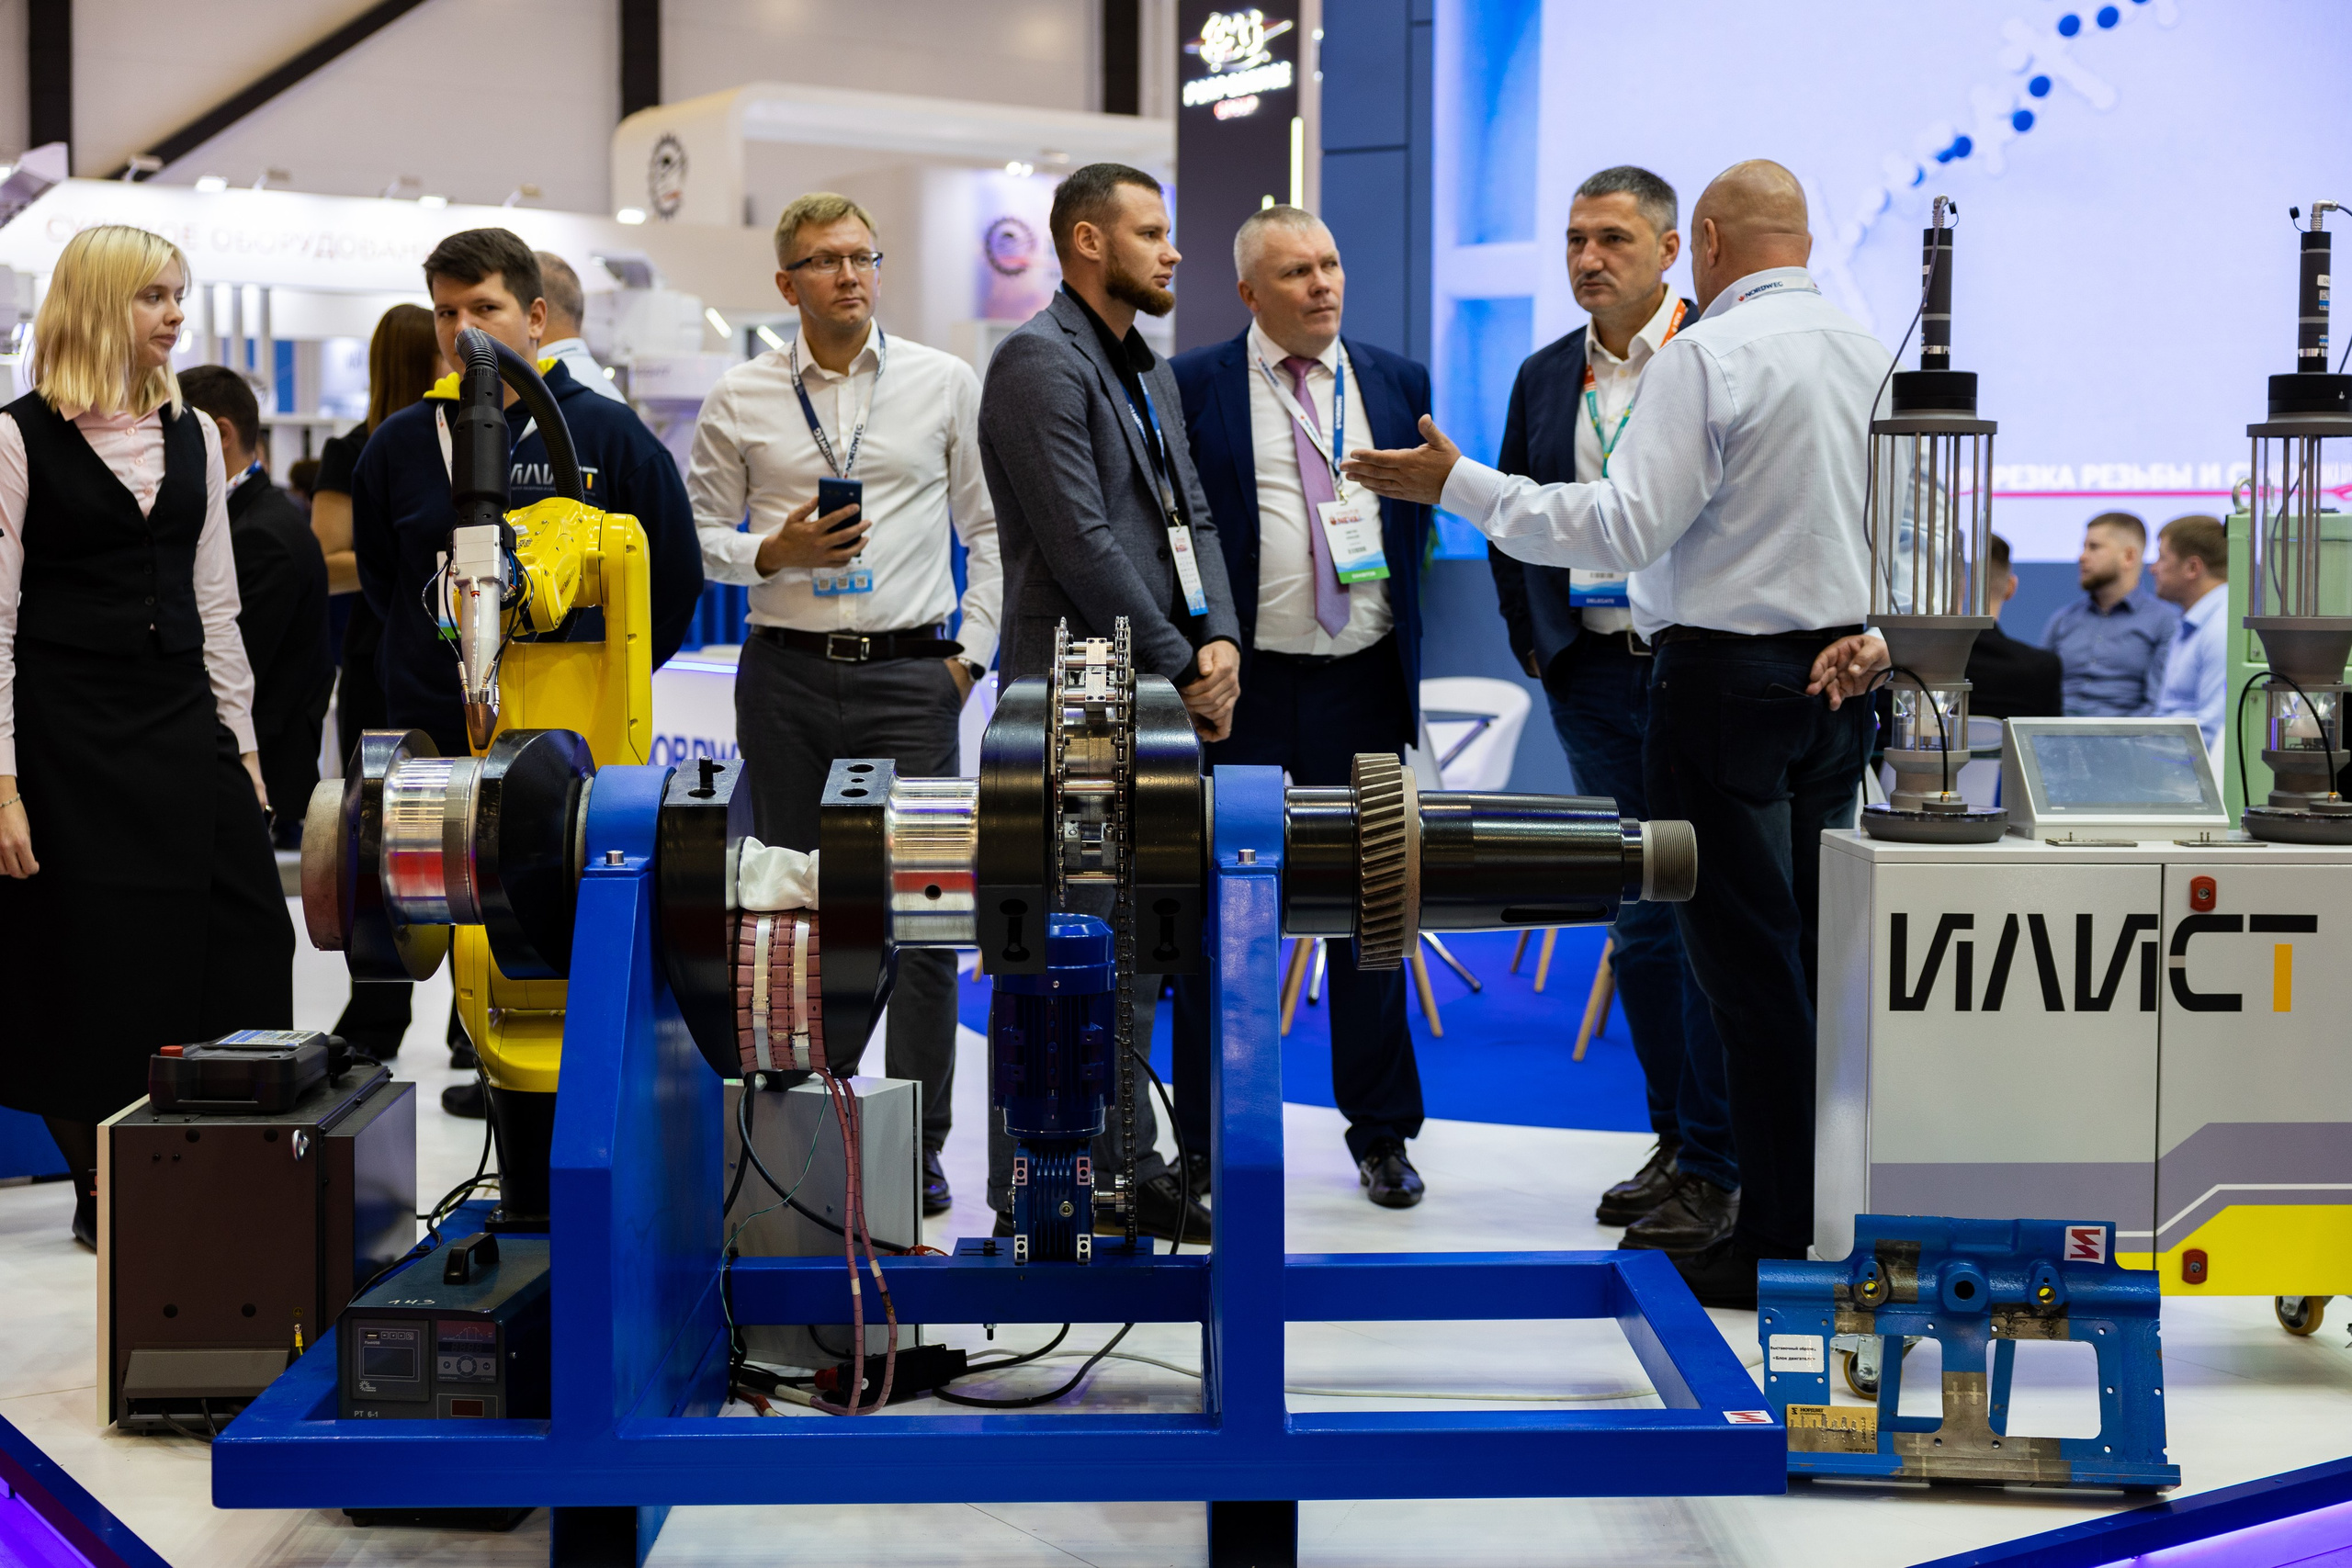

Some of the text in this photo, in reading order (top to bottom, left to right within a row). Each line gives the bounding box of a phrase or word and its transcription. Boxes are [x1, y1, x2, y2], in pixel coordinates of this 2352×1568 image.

[845, 423, 864, 471] NORDWEG
[2081, 463, 2191, 490] РЕЗЬБЫ
[2199, 462, 2221, 489] И
[1889, 912, 2318, 1012] ИЛИСТ
